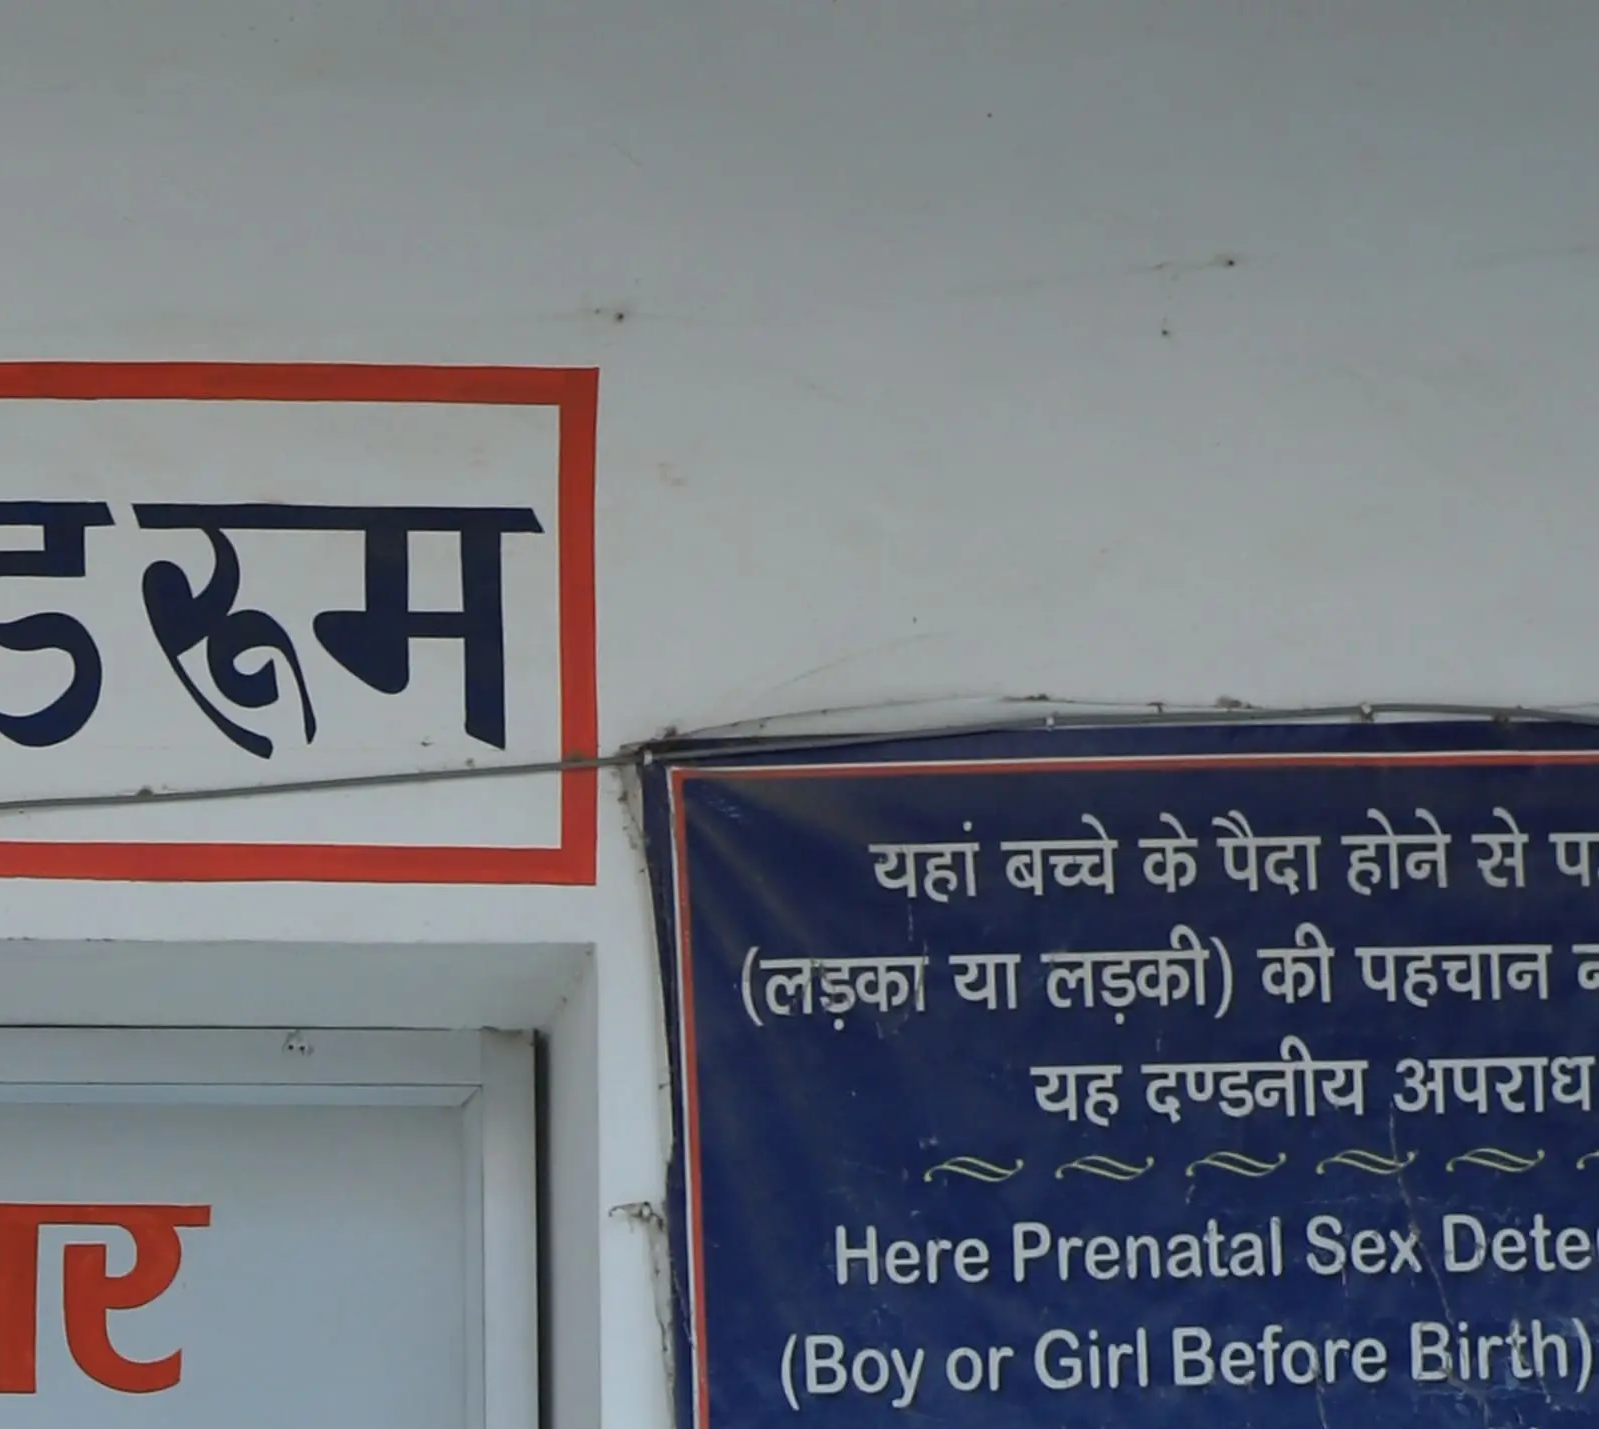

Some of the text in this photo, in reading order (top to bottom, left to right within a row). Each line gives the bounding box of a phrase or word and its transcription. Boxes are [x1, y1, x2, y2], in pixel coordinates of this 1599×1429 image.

[134, 502, 544, 759] रूम
[869, 806, 1599, 902] यहां बच्चे के पैदा होने से प
[741, 946, 929, 1032] (लड़का
[949, 953, 1020, 1011] या
[1041, 923, 1235, 1026] लड़की)
[1257, 922, 1334, 1004] की
[1355, 944, 1553, 1008] पहचान
[1031, 1036, 1596, 1128] यह दण्डनीय अपराध
[835, 1213, 1599, 1286] Here Prenatal Sex Dete
[781, 1317, 1593, 1410] (Boy or Girl Before Birth)
